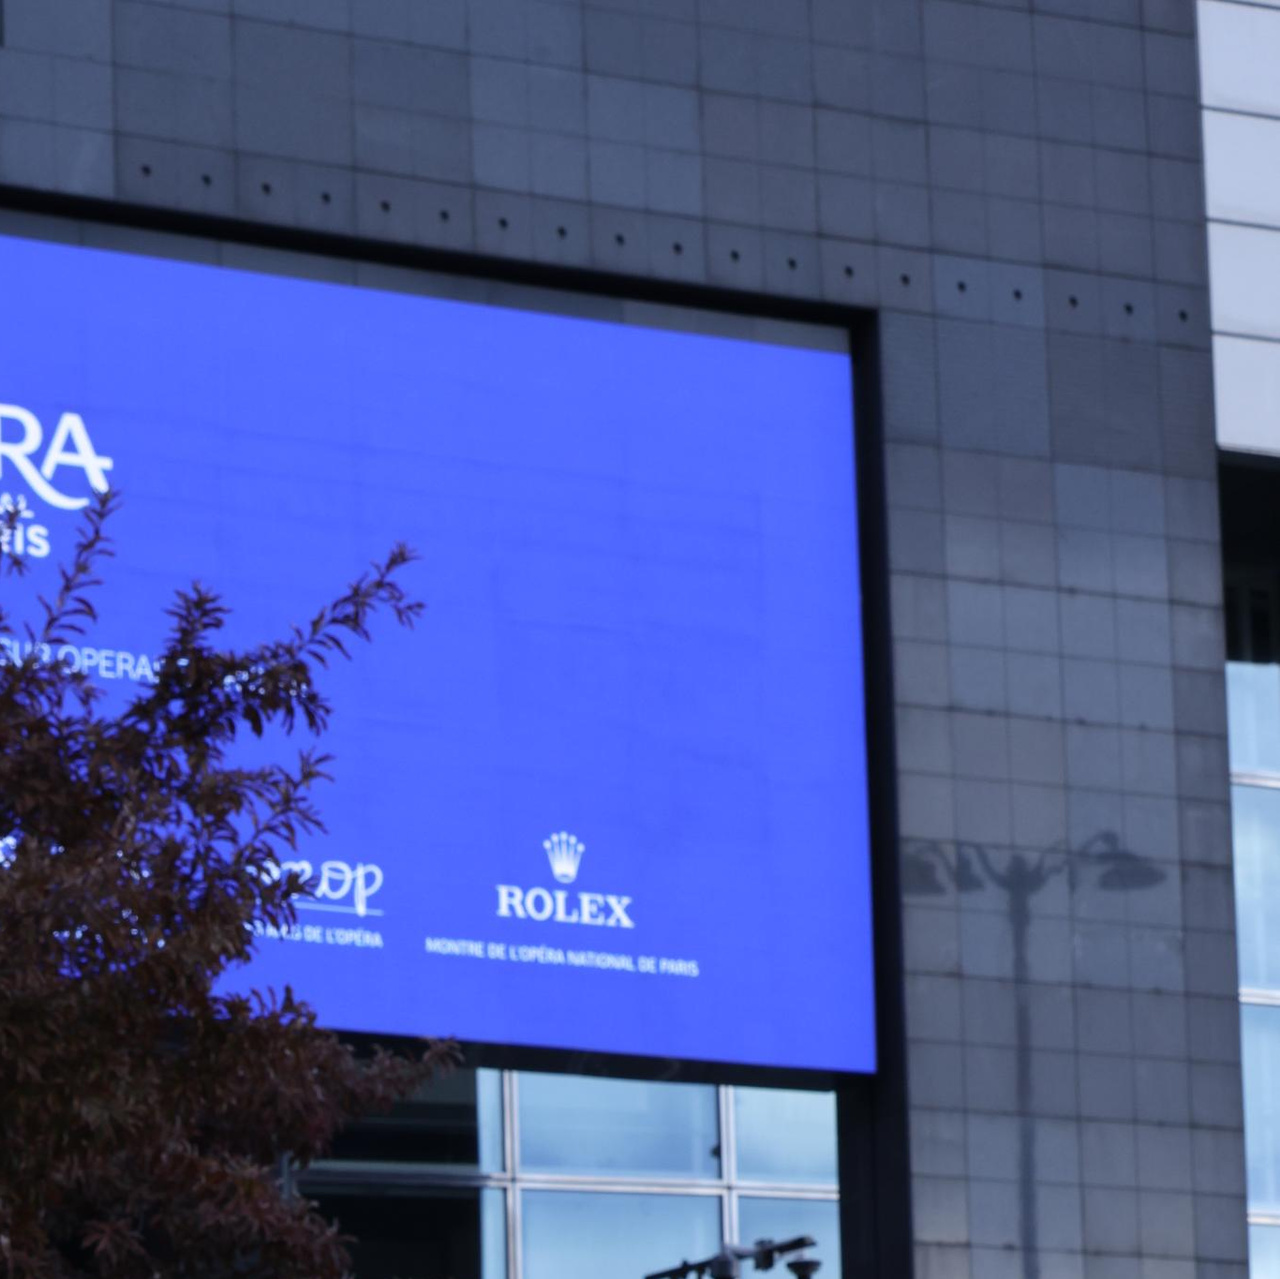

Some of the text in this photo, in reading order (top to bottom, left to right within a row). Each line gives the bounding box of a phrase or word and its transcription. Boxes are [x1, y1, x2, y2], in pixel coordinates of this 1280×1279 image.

[495, 884, 635, 929] ROLEX
[303, 924, 324, 943] DE
[425, 937, 486, 958] MONTRE
[487, 941, 507, 960] DE
[566, 950, 636, 972] NATIONAL
[637, 955, 658, 974] DE
[659, 957, 700, 978] PARIS
